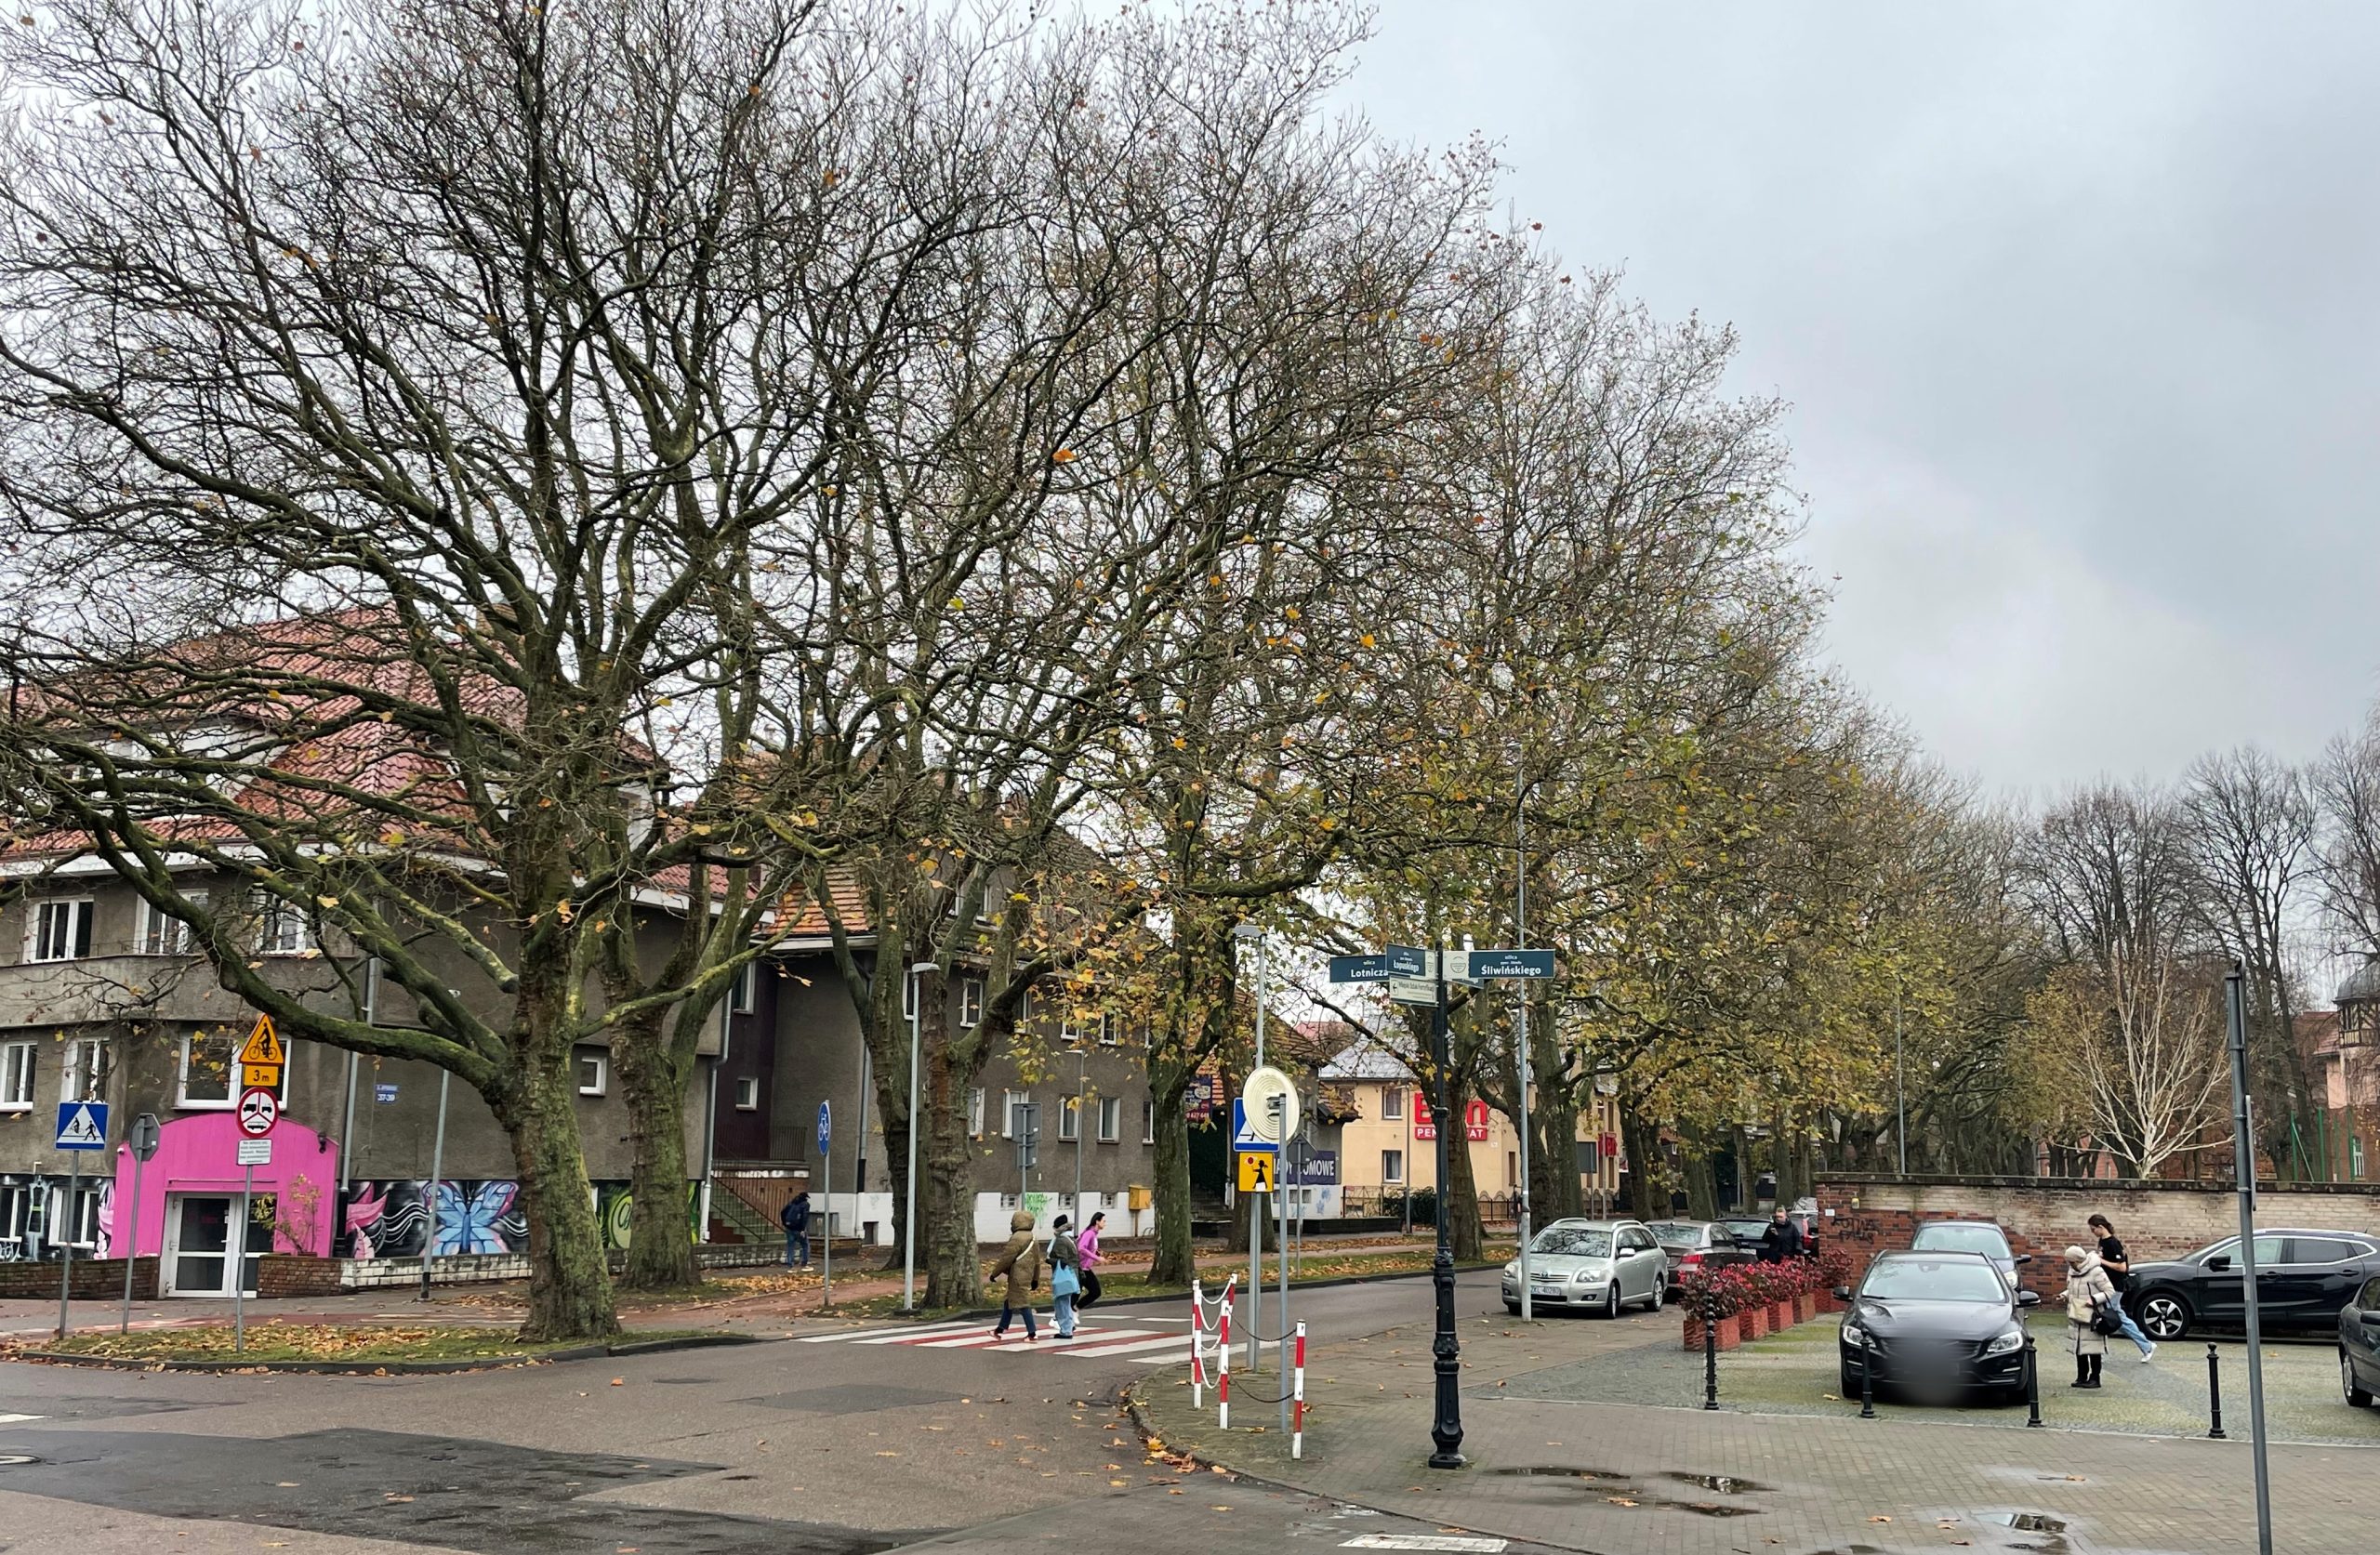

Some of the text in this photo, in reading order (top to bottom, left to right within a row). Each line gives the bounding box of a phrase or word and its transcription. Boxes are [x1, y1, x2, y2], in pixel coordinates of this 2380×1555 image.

[1351, 968, 1388, 978] Lotnicza
[1481, 965, 1541, 976] Śliwińskiego
[253, 1070, 260, 1081] 3
